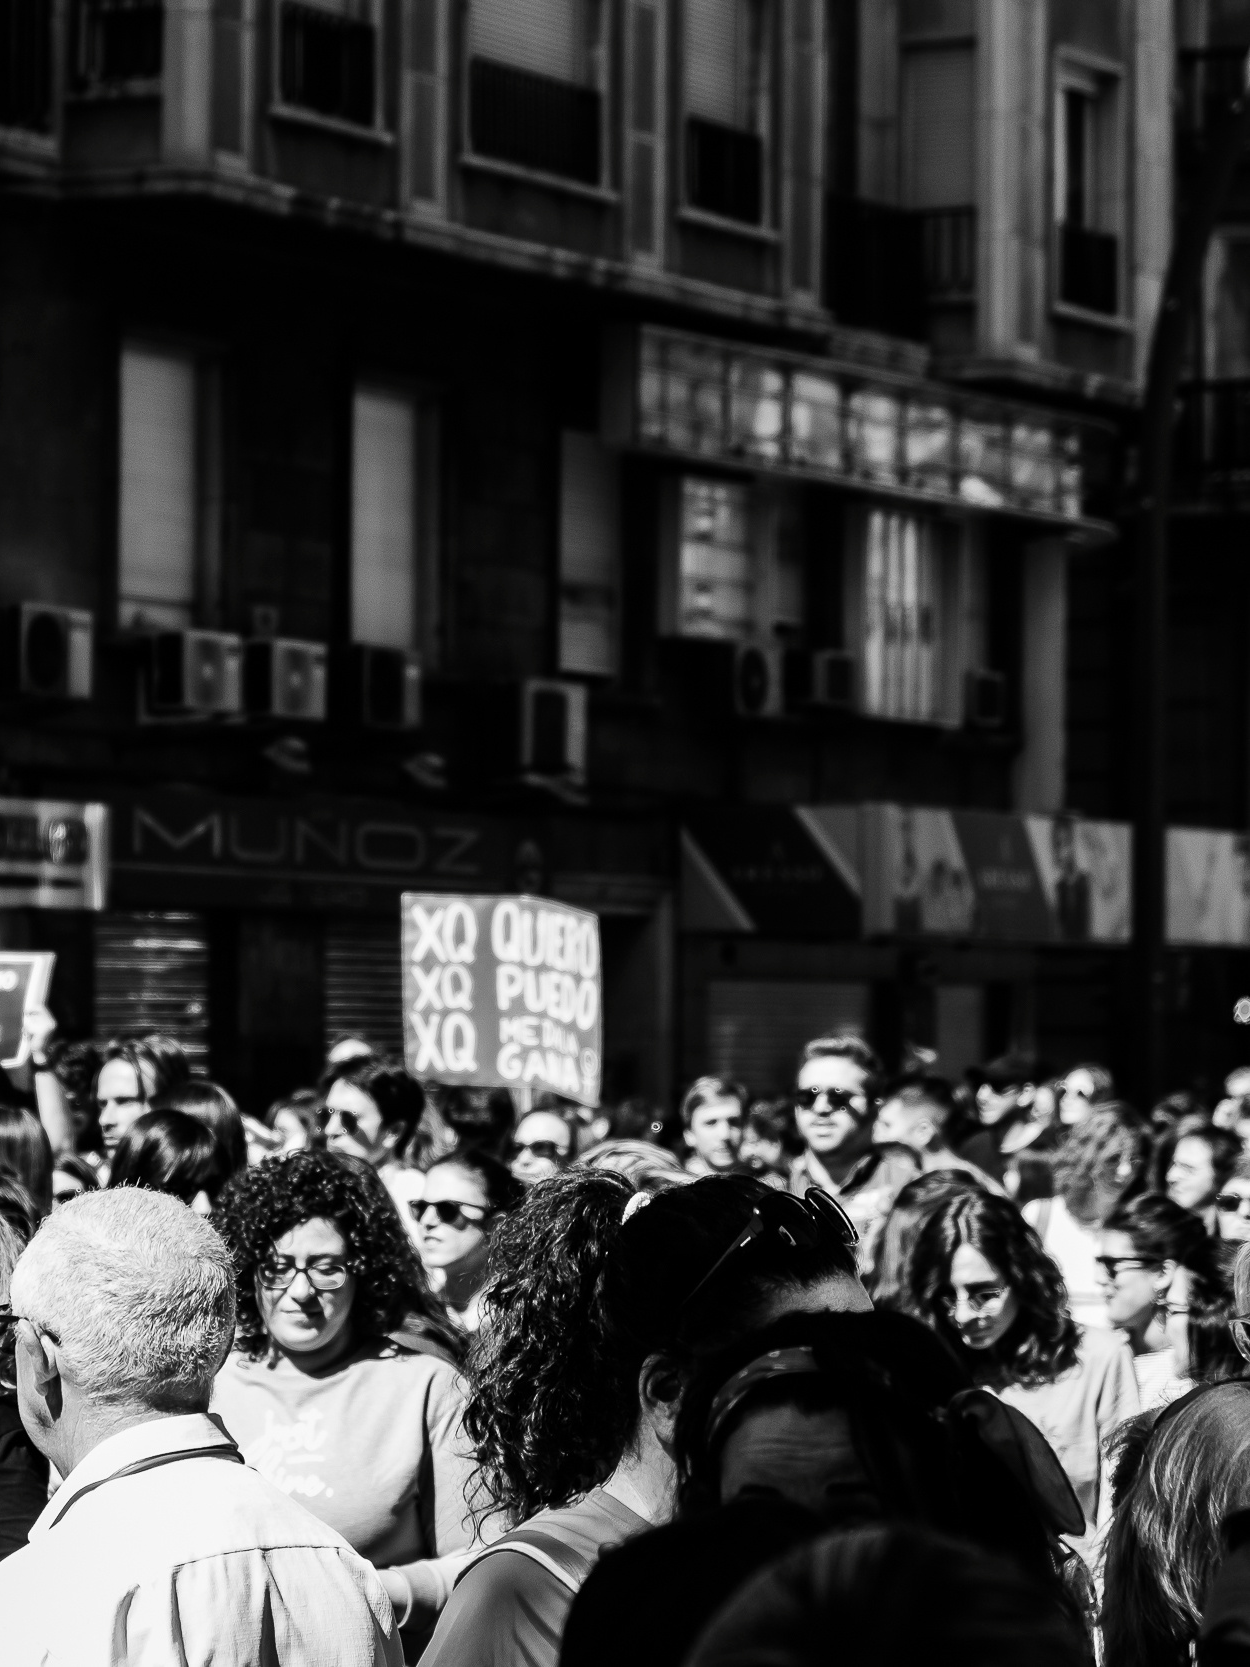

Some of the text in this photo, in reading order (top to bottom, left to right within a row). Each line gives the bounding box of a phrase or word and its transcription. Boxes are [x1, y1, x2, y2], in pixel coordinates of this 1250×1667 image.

[131, 803, 481, 873] MUÑOZ
[410, 902, 479, 964] XQ
[410, 963, 598, 1031] XQ PUEDO
[408, 1011, 478, 1073] XQ
[499, 1015, 540, 1046] ME
[496, 1042, 580, 1092] GANA
